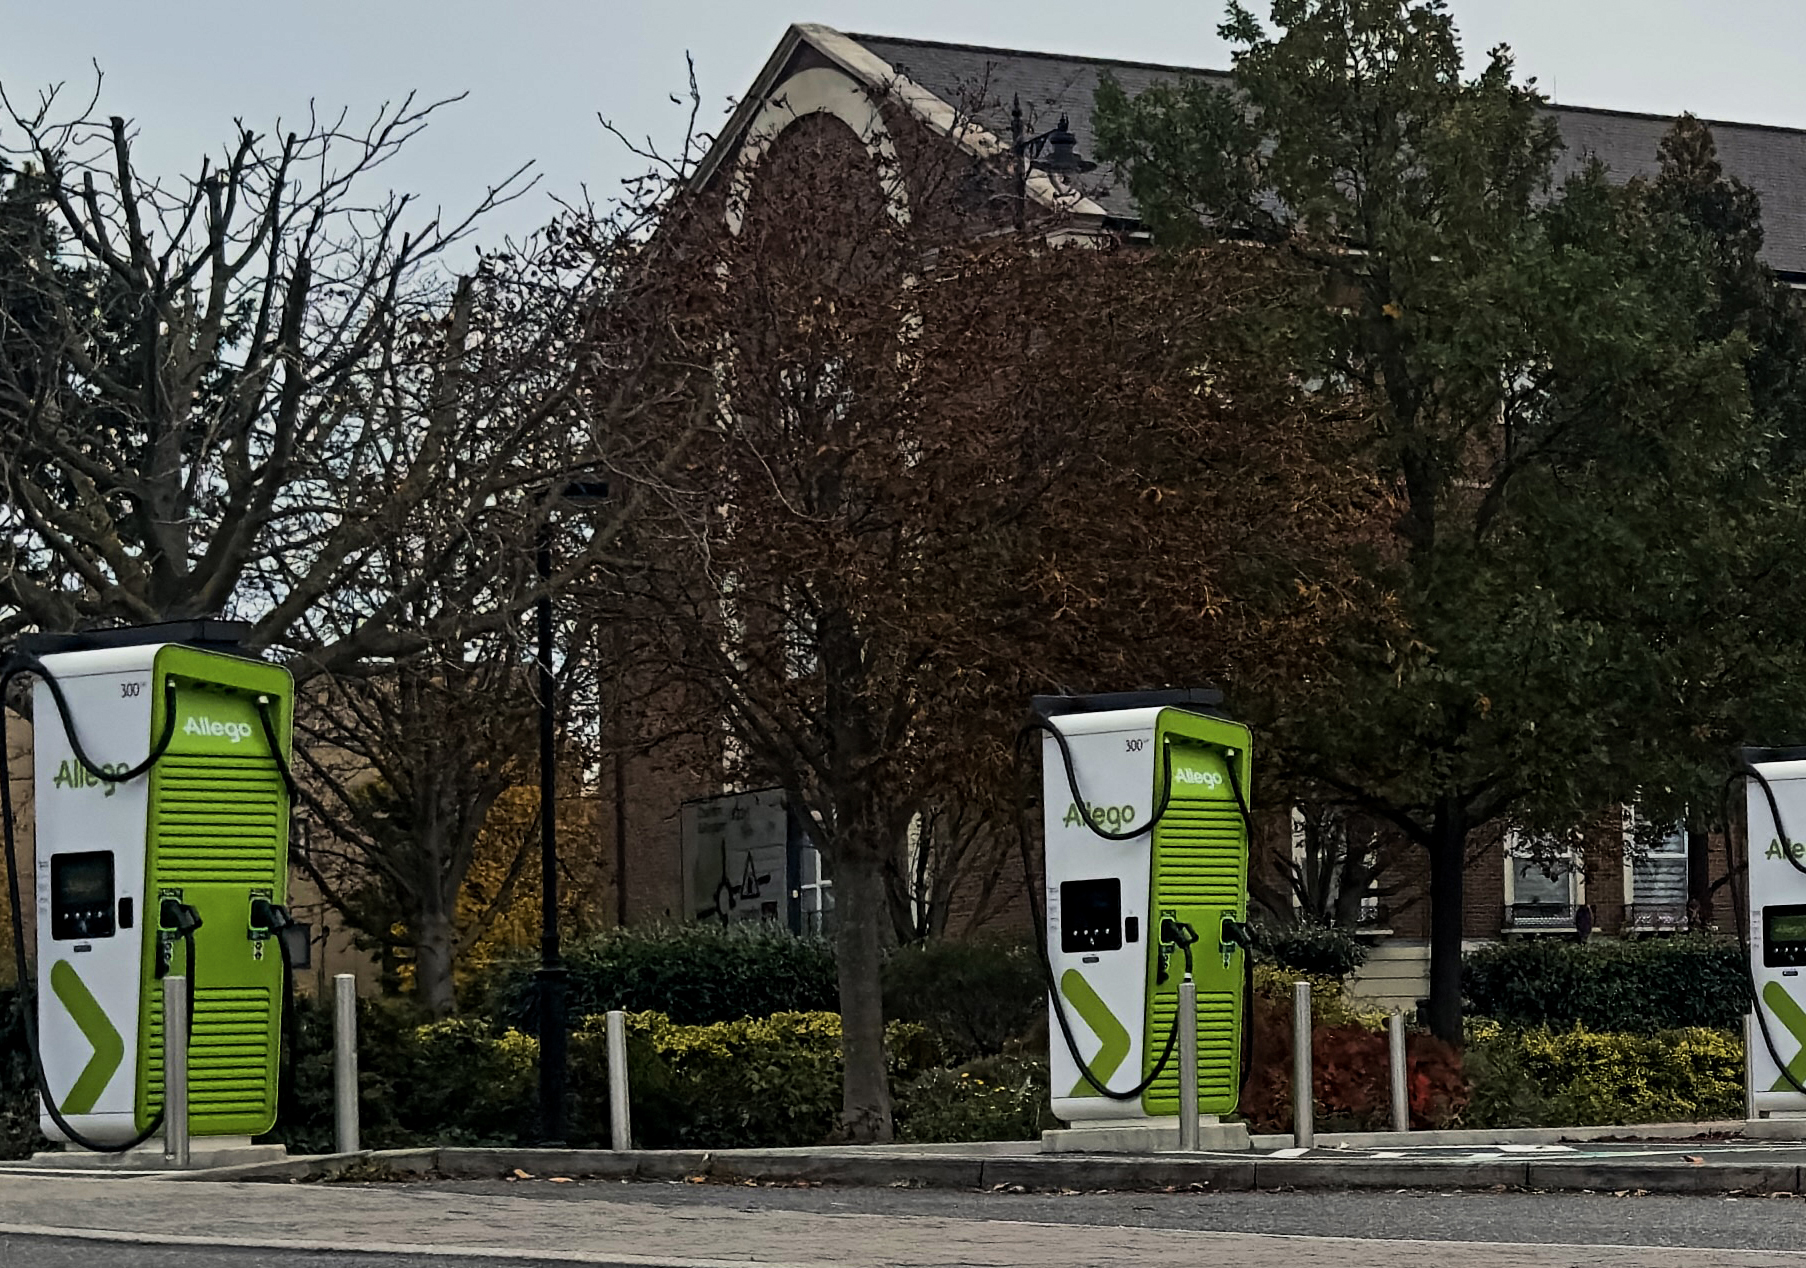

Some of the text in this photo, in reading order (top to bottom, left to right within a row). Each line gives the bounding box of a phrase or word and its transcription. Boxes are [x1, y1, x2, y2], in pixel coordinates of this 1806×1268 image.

[121, 682, 140, 698] 300
[183, 716, 252, 743] Allego
[1125, 739, 1143, 752] 300
[1175, 767, 1223, 790] Allego
[1062, 801, 1135, 834] Alego
